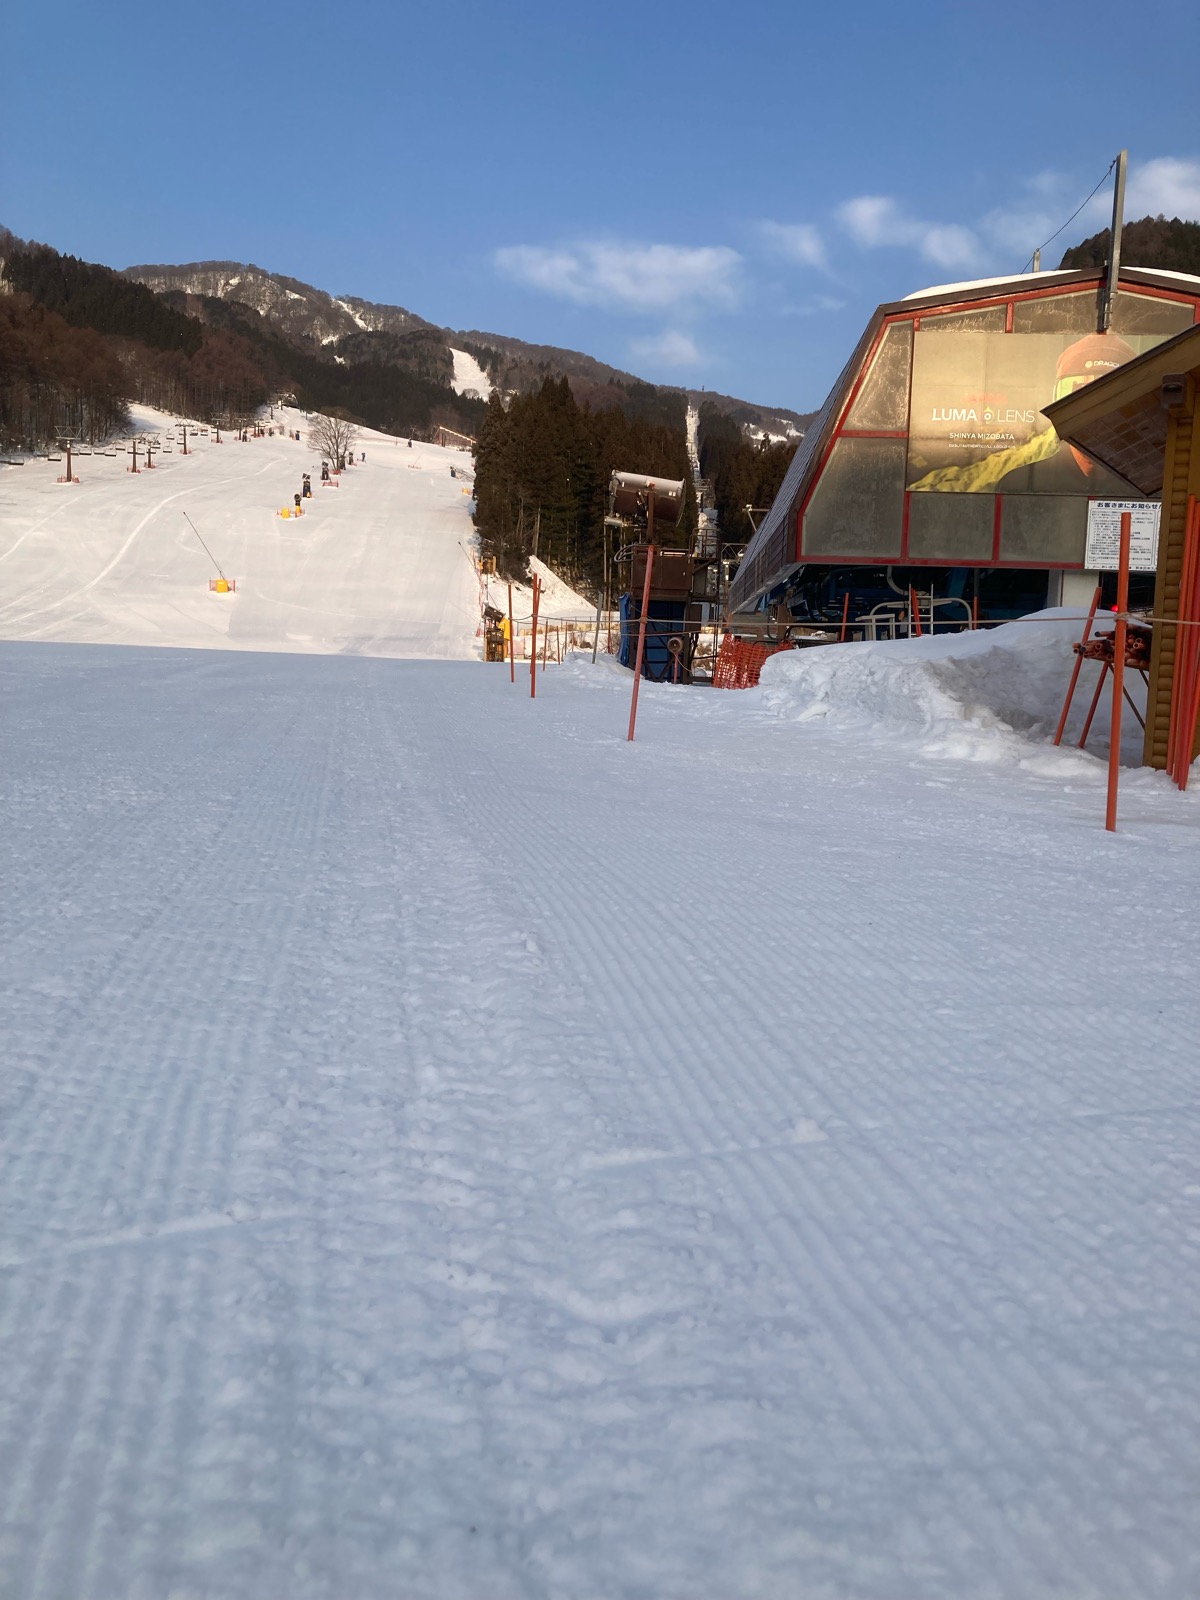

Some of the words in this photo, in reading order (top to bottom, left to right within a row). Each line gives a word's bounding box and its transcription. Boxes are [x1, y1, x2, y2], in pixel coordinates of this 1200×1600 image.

[932, 408, 977, 422] LUMA
[997, 409, 1035, 423] LENS
[1097, 502, 1162, 510] お客さまにお知らせ
